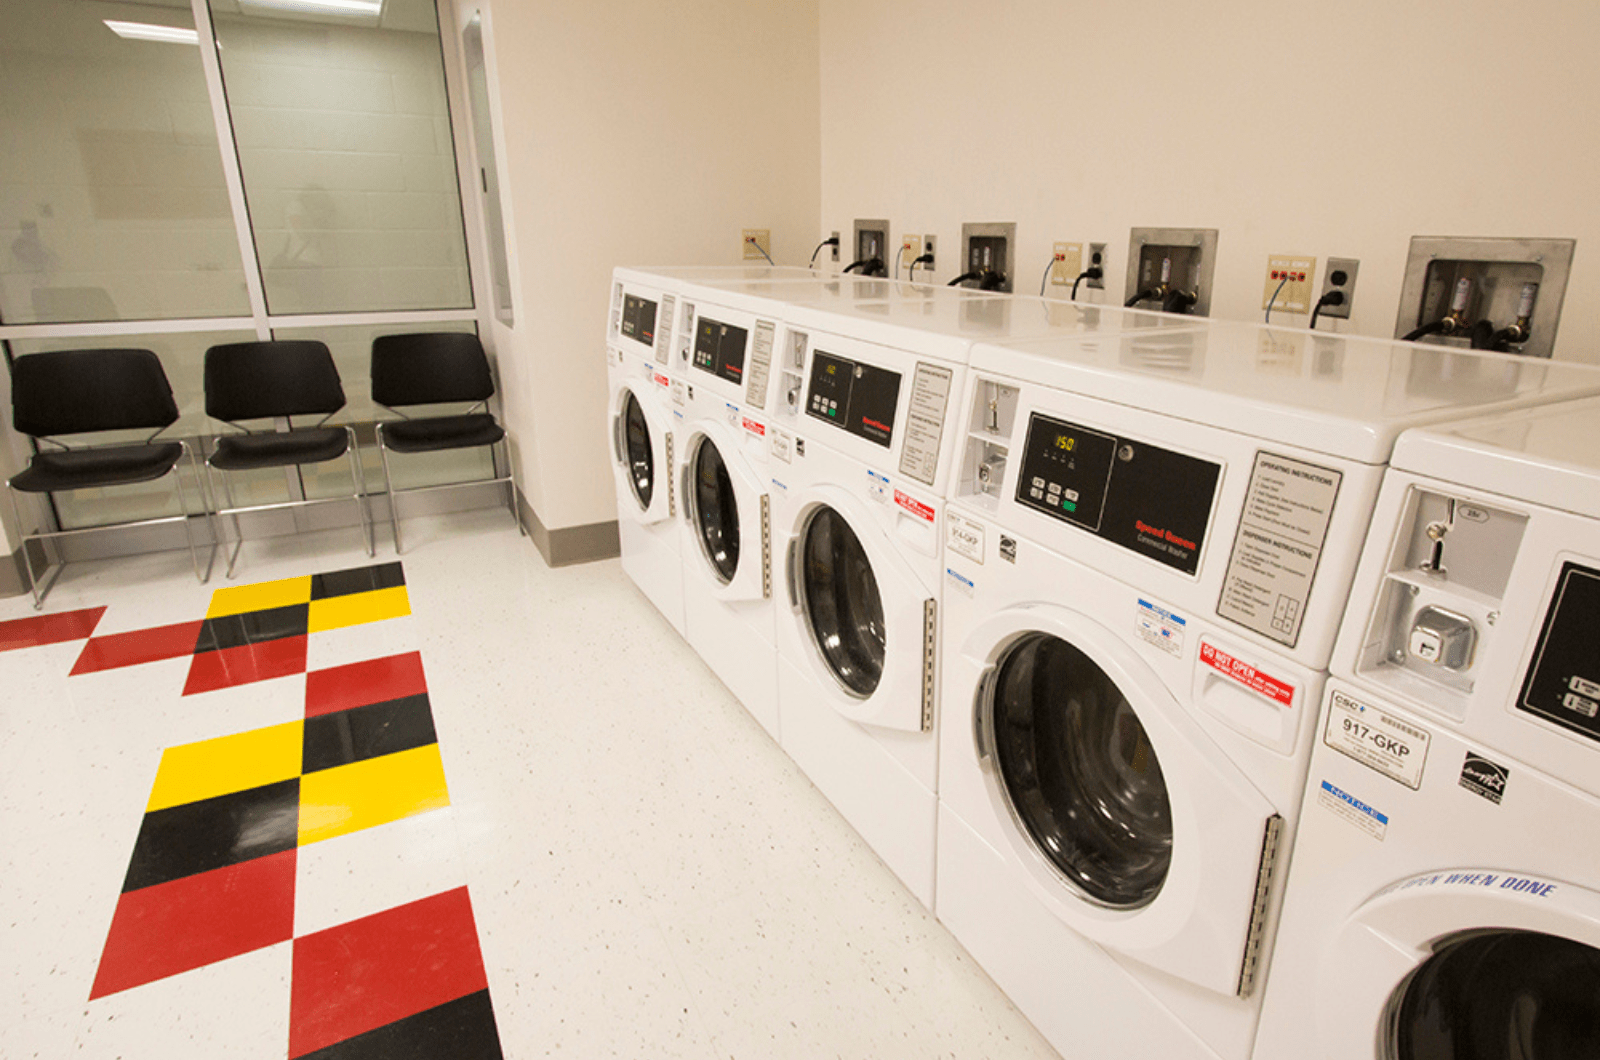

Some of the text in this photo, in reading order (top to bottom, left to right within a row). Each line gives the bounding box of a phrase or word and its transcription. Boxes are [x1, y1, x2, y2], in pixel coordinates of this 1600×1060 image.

[1056, 435, 1075, 451] 150
[1260, 460, 1333, 486] OPERATING INSTRUCTIONS
[1135, 519, 1164, 538] Speed
[1273, 540, 1312, 560] INSTRUCTIONS
[1202, 643, 1215, 659] DO
[1215, 650, 1231, 667] NOT
[1232, 660, 1255, 678] OPEN
[1335, 694, 1358, 710] CSC
[1343, 718, 1410, 757] 917-GKP
[1330, 786, 1378, 818] NOTICE
[1444, 873, 1498, 886] WHEN
[1500, 876, 1557, 897] DONE
